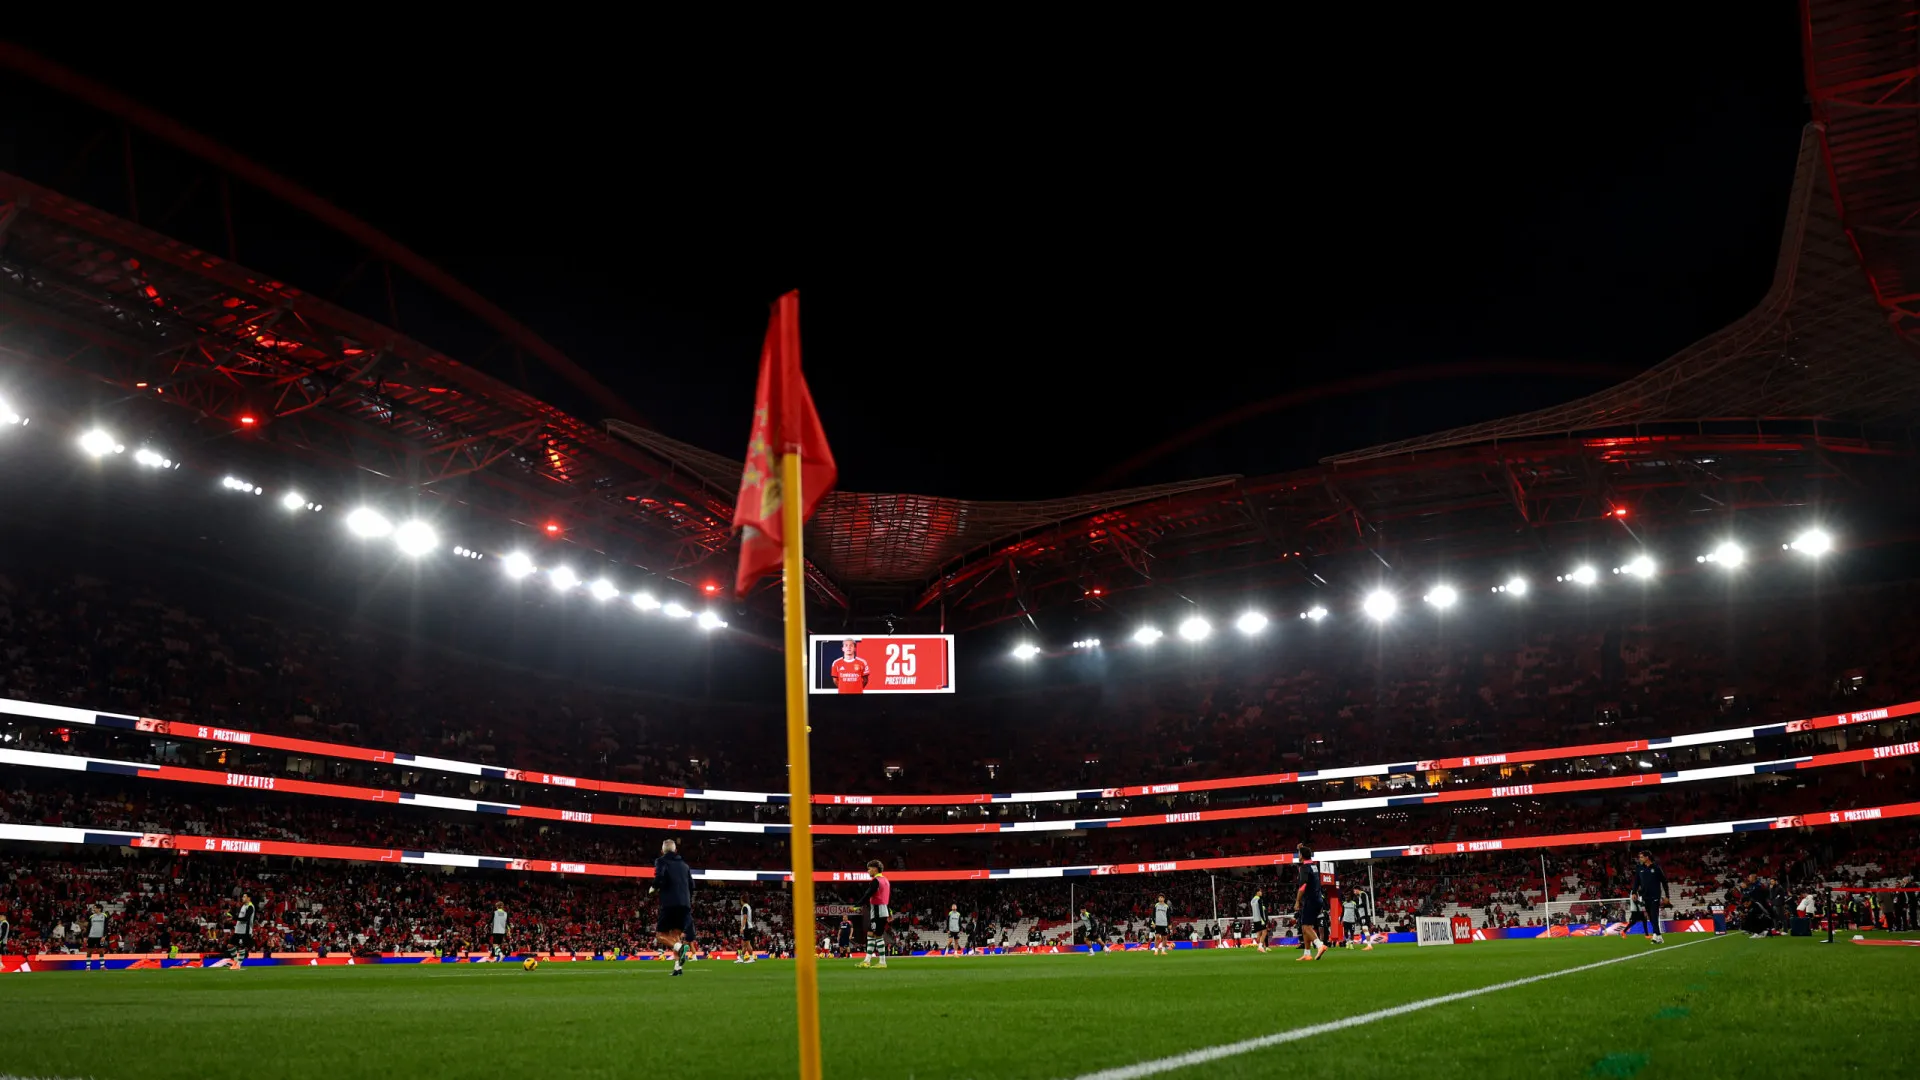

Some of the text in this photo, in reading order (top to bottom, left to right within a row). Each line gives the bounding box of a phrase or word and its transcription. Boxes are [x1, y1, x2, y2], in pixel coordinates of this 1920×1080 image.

[886, 644, 916, 676] 25
[885, 677, 916, 685] PRESTIANNI
[1838, 709, 1888, 724] 25 PRESTIANNI
[198, 727, 251, 743] 25 PRESTIANNI
[1873, 742, 1919, 758] SUPLENTES
[1475, 754, 1506, 765] PRESTIANNI
[227, 773, 274, 789] SUPLENTES
[1492, 785, 1533, 797] SUPLENTES
[562, 811, 592, 822] SUPLENTES
[1166, 812, 1200, 822] SUPLENTES
[1830, 809, 1881, 822] 25 PRESTIANNI
[858, 825, 893, 834] SUPLENTES
[205, 839, 261, 852] 25 PRESTIANNI
[1469, 840, 1502, 851] PRESTIANNI
[1422, 922, 1431, 941] LIGA
